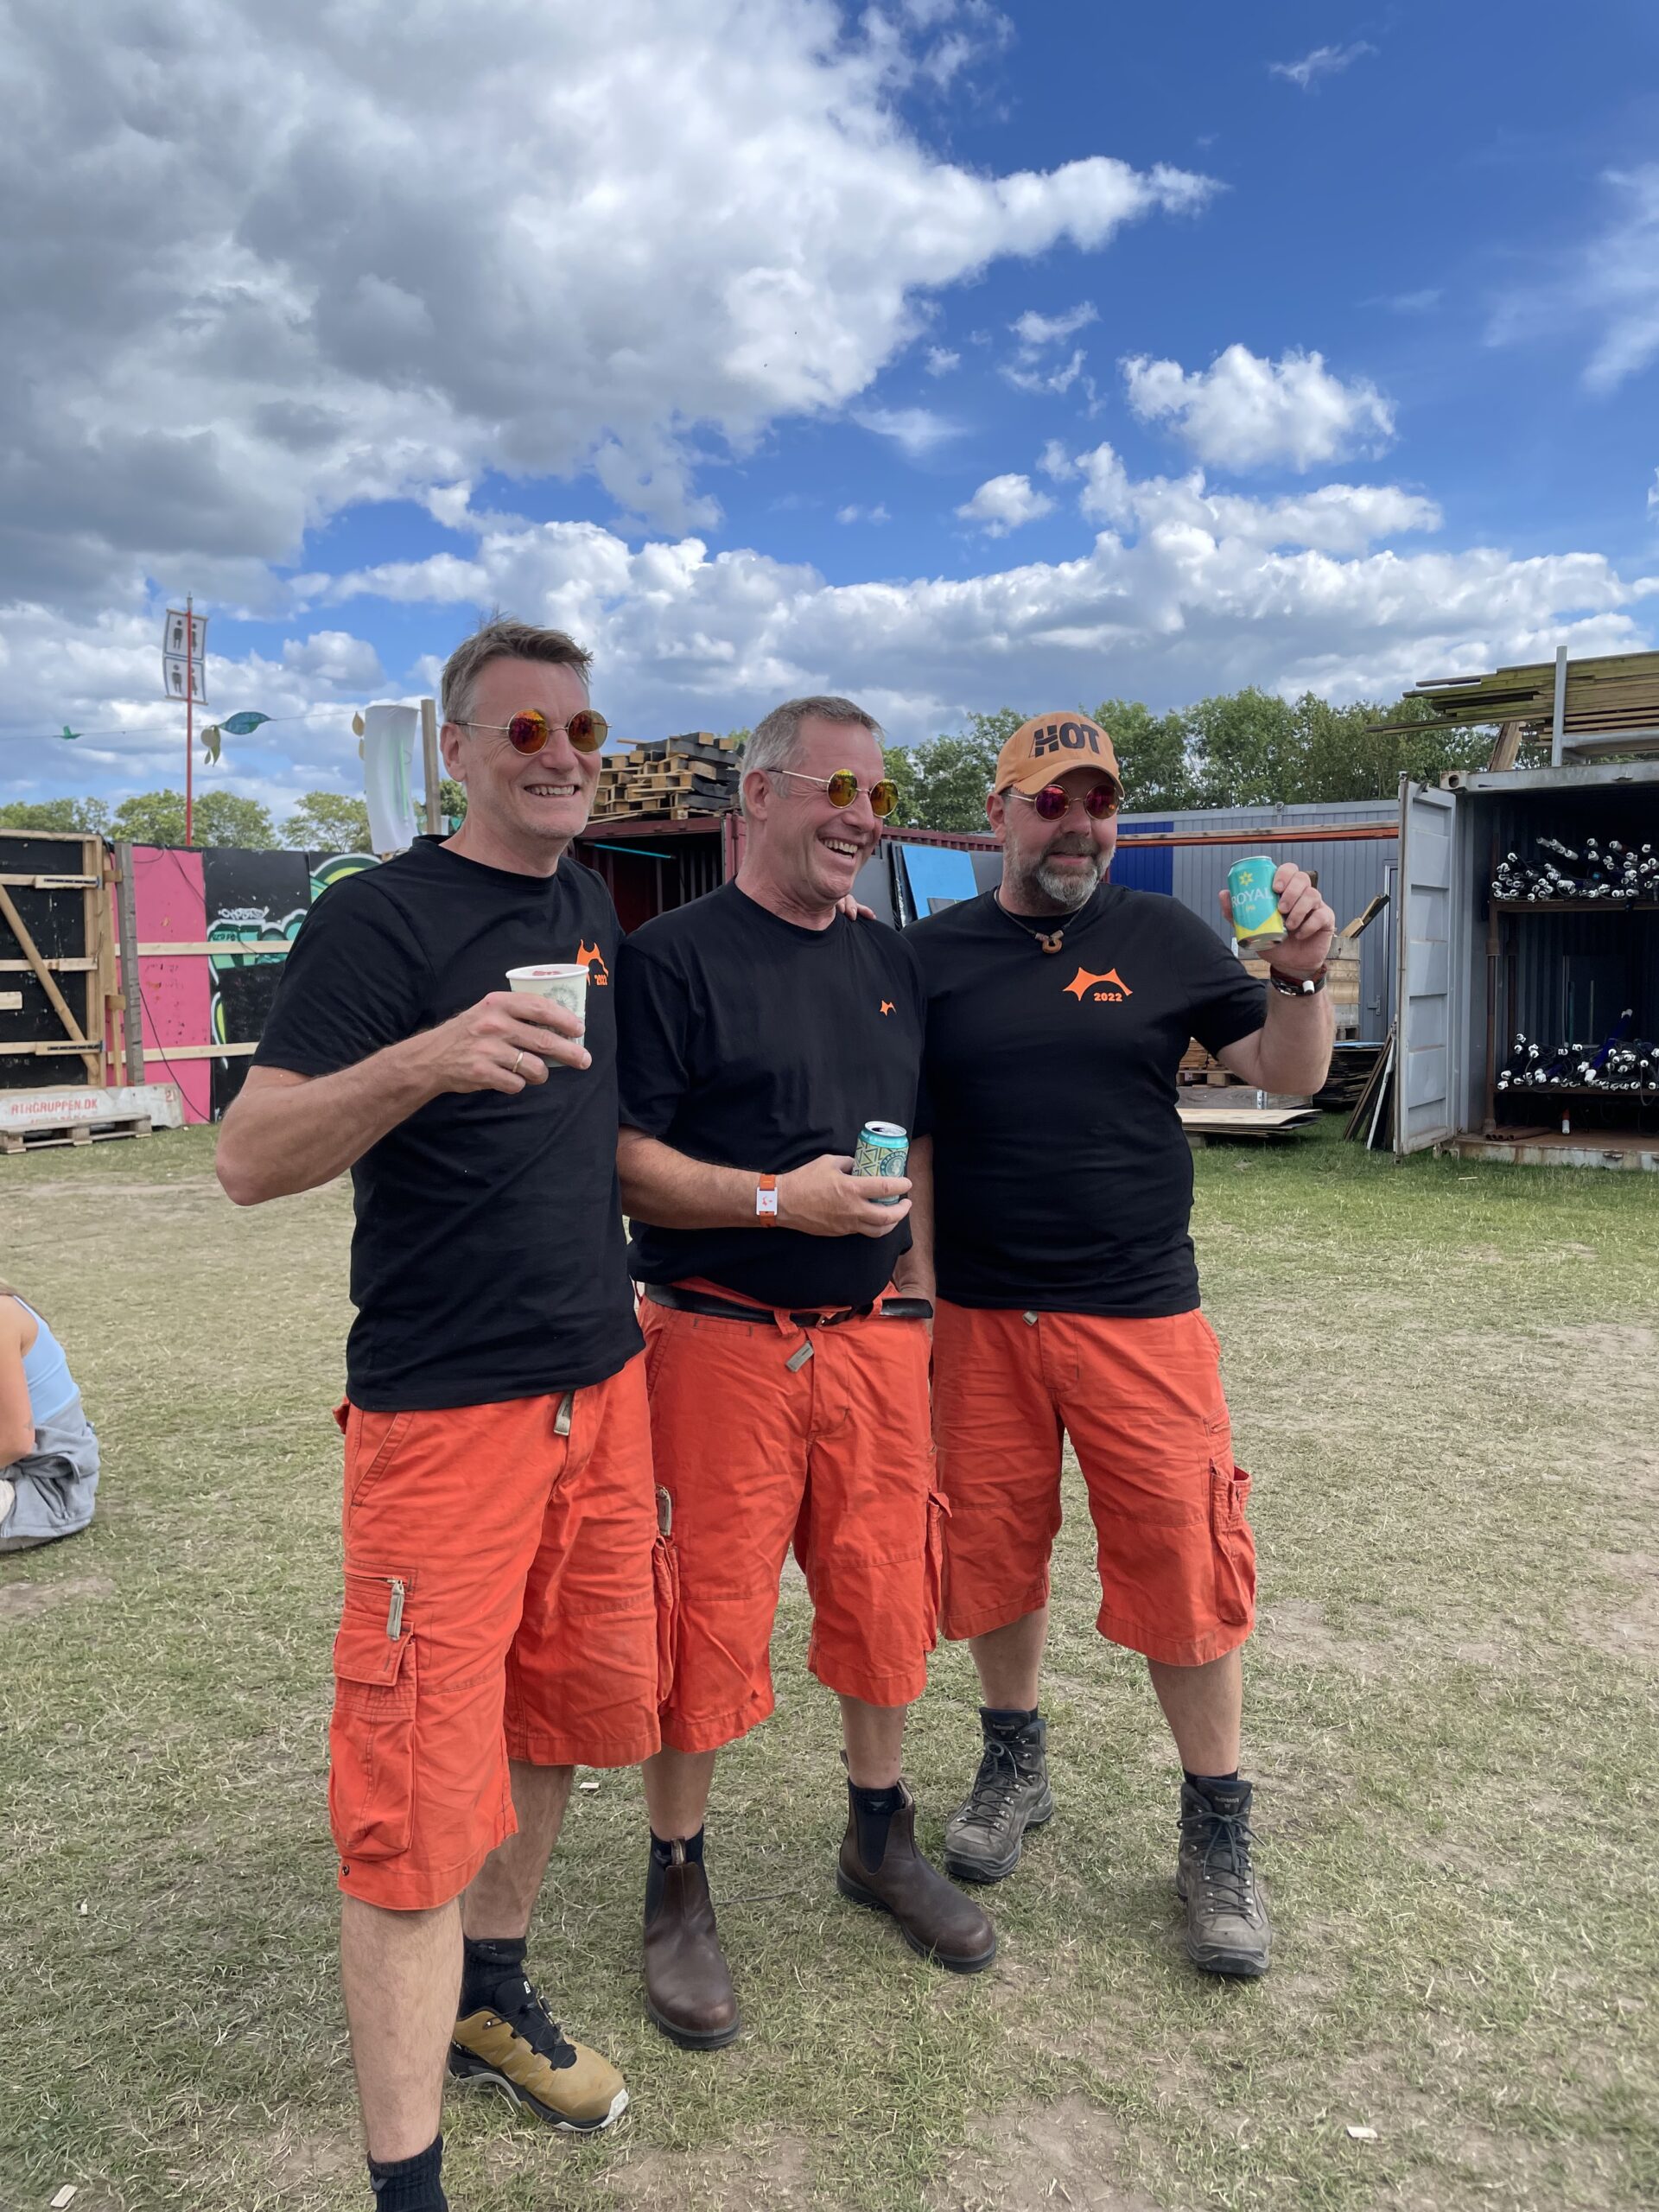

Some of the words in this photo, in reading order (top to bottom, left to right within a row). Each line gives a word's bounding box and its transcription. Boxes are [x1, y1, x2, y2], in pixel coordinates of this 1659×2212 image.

[1028, 721, 1100, 759] HOT
[1231, 887, 1274, 907] ROYAL
[1093, 992, 1123, 1002] 2022
